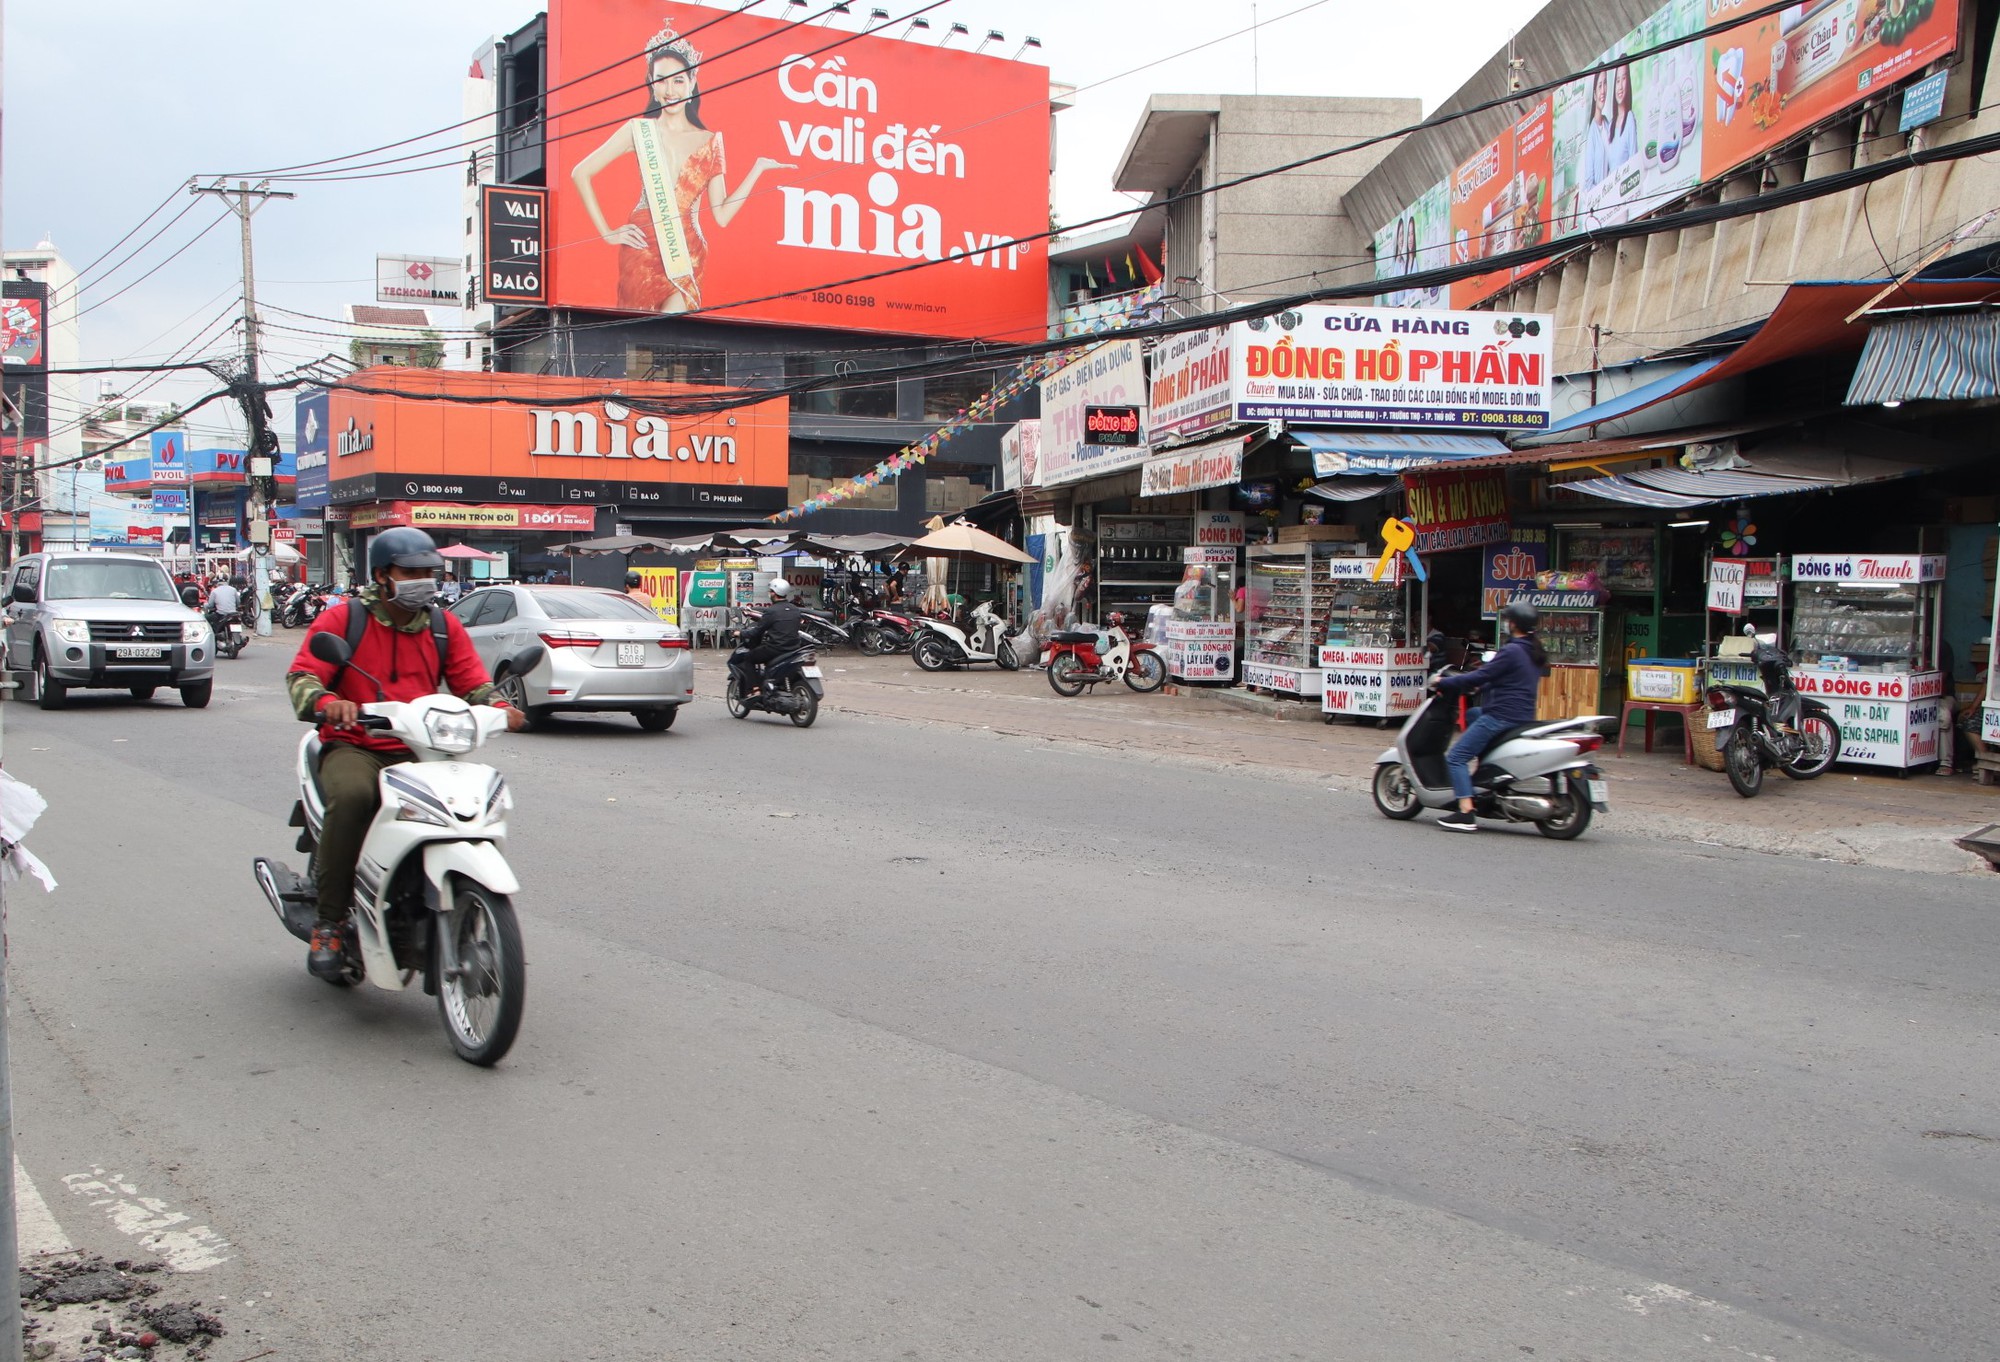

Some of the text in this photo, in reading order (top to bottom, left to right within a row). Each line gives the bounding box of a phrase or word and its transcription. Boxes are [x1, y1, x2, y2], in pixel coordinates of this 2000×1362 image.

[1811, 26, 1831, 50] Châu
[777, 53, 878, 113] Cần
[1907, 78, 1942, 101] PACIFIC
[778, 116, 965, 178] vali đến
[640, 121, 681, 262] MISS GRAND INTERNATIONAL
[504, 201, 538, 219] VALI
[777, 171, 1018, 271] mia.vn
[510, 237, 538, 256] TÚI
[493, 271, 539, 291] BALÔ
[383, 287, 458, 300] TECHCOMBANK
[812, 292, 875, 307] 1800 6198
[886, 300, 947, 314] www.mia.vn
[1324, 312, 1470, 336] CỬA HÀNG
[1171, 328, 1210, 360] CỬA HÀNG
[1177, 356, 1190, 401] HỒ
[1190, 338, 1230, 395] PHẤN
[1246, 334, 1546, 387] ĐỒNG HỒ PHẤN
[1046, 342, 1132, 403] BẾP GAS ĐIỆN GIA DỤNG
[1278, 385, 1296, 400] MUA
[1298, 385, 1315, 400] BÁN
[1322, 383, 1339, 401] SỬA
[1342, 385, 1363, 401] CHỮA
[1371, 388, 1390, 402] TRAO
[1408, 387, 1424, 403] CÁC
[1426, 389, 1444, 406] LOẠI
[1482, 391, 1508, 405] MODEL
[1525, 390, 1541, 407] MỚI
[1088, 409, 1120, 432] ĐỒNG
[1120, 409, 1138, 432] HỒ
[1462, 412, 1479, 423] ĐT:
[1481, 413, 1543, 424] 0908.188.403
[338, 416, 374, 457] mia.vn
[529, 399, 737, 465] mia.vn
[216, 453, 240, 470] PV
[1044, 446, 1070, 473] Rinnai
[154, 471, 184, 480] PVOIL
[155, 494, 184, 504] PVOIL
[422, 486, 464, 495] 1800 6198
[510, 489, 526, 497] VALI
[584, 489, 596, 498] TÚI
[640, 493, 649, 501] BA
[713, 494, 742, 504] PHỤ KIỆN
[1408, 474, 1436, 526] SỬA
[1437, 485, 1448, 523] &
[1449, 472, 1469, 521] MỞ
[1470, 470, 1506, 518] KHÓA
[415, 510, 514, 523] BẢO HÀNH TRỌN ĐỜI
[524, 513, 531, 523] 1
[1211, 512, 1231, 523] SỬA
[276, 531, 293, 539] ATM
[1199, 523, 1227, 544] ĐỒNG
[1430, 527, 1447, 550] CÁC
[1333, 561, 1362, 574] ĐỒNG HỒ
[1492, 546, 1536, 581] SỬA
[1798, 555, 1831, 577] ĐỒNG
[1834, 555, 1852, 577] HỒ
[1857, 558, 1914, 581] Thanh
[703, 579, 724, 587] Castrol
[787, 574, 820, 586] LOAN
[1713, 564, 1743, 586] NƯỚC
[659, 575, 675, 603] VỊT
[1532, 591, 1562, 607] CHÌA
[1563, 591, 1595, 607] KHÓA
[1715, 588, 1735, 609] MÍA
[624, 644, 639, 655] 51G
[1188, 640, 1202, 652] SỬA
[1202, 640, 1221, 652] ĐỒNG
[1322, 651, 1384, 665] OMEGA LONGINES
[1395, 653, 1424, 665] OMEGA
[1273, 672, 1295, 689] PHẤN
[1327, 670, 1382, 687] SỬA ĐỒNG HỒ
[1391, 670, 1424, 687] ĐỒNG HỒ
[1822, 672, 1903, 697] ĐỒNG HỒ
[1326, 690, 1381, 710] THAY PIN DÂY
[1358, 700, 1377, 713] KIẾNG
[1844, 702, 1890, 722] PIN DÂY
[1864, 728, 1899, 745] SAPHIA
[1909, 730, 1936, 761] Thanh
[1841, 746, 1877, 760] Liền
